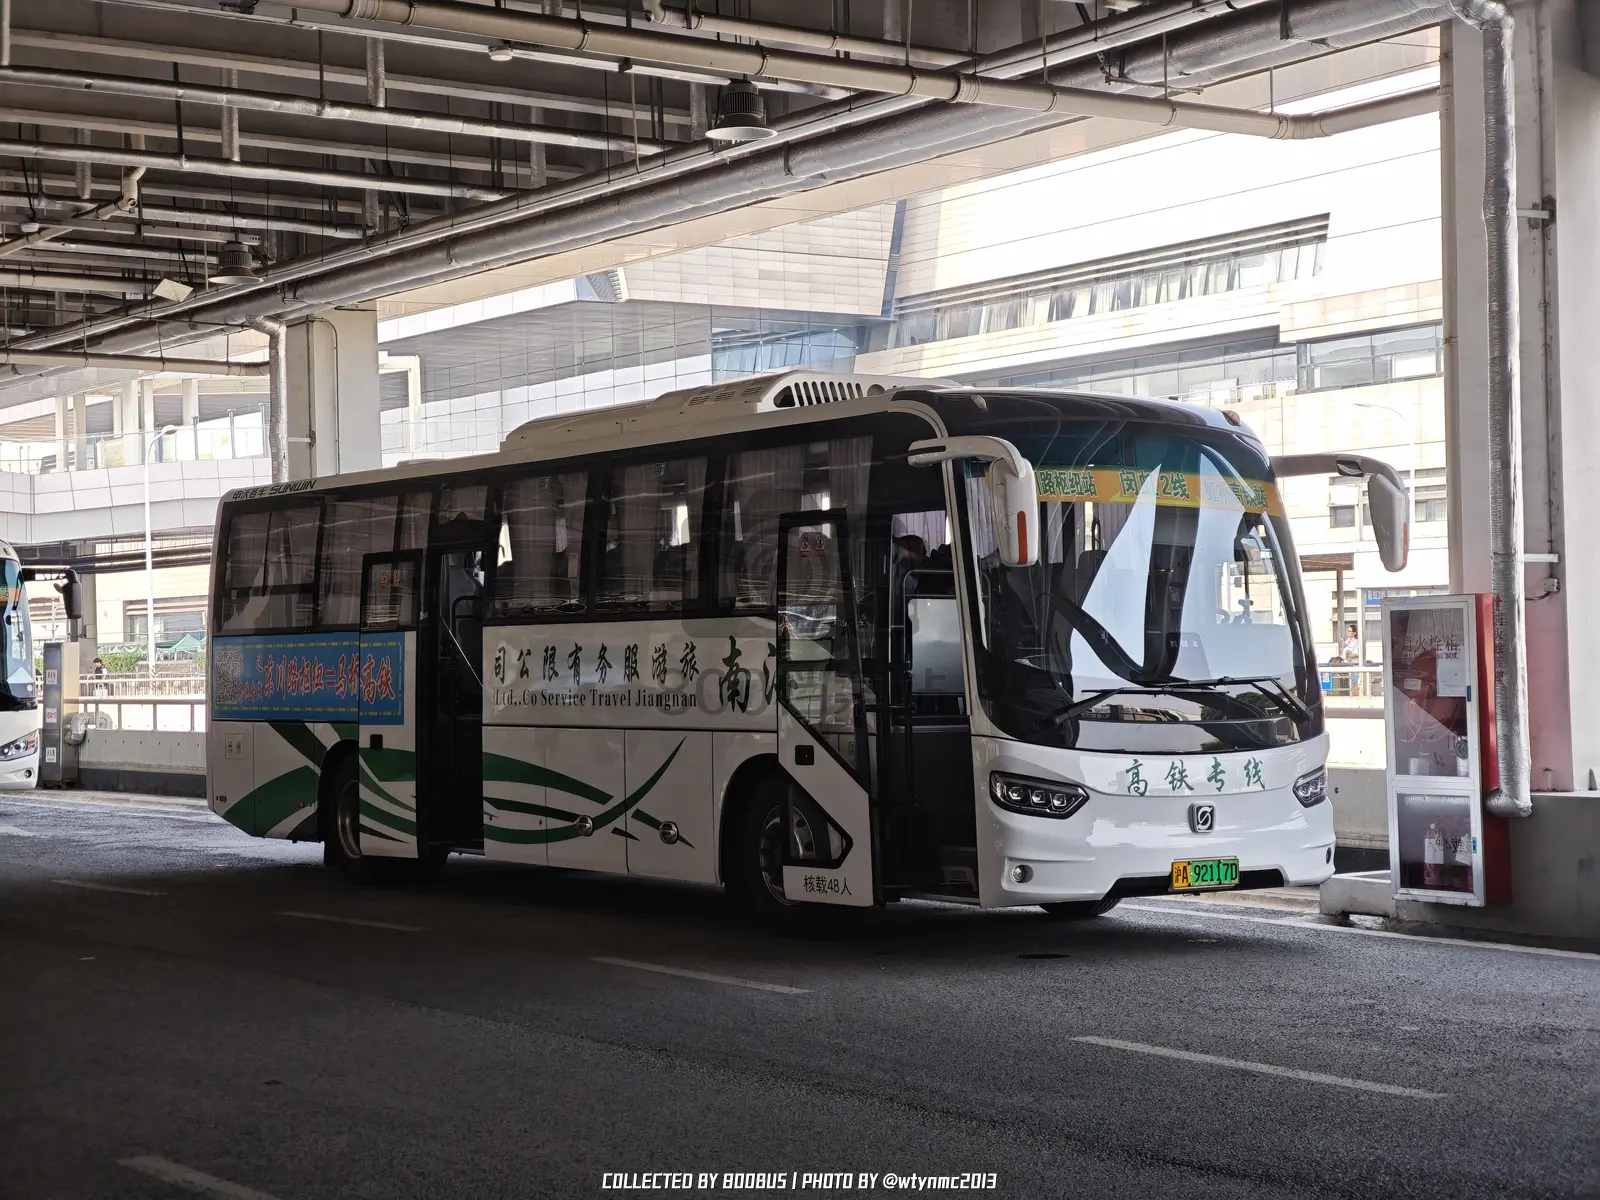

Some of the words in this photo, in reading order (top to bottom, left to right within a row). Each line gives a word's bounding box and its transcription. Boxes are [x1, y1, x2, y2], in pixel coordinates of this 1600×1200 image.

[268, 479, 318, 496] SUNWIN
[541, 688, 587, 707] Service
[589, 688, 632, 707] Travel
[635, 688, 698, 711] Jiangnan
[1125, 757, 1266, 797] 高铁专线
[803, 875, 853, 896] 核载48人
